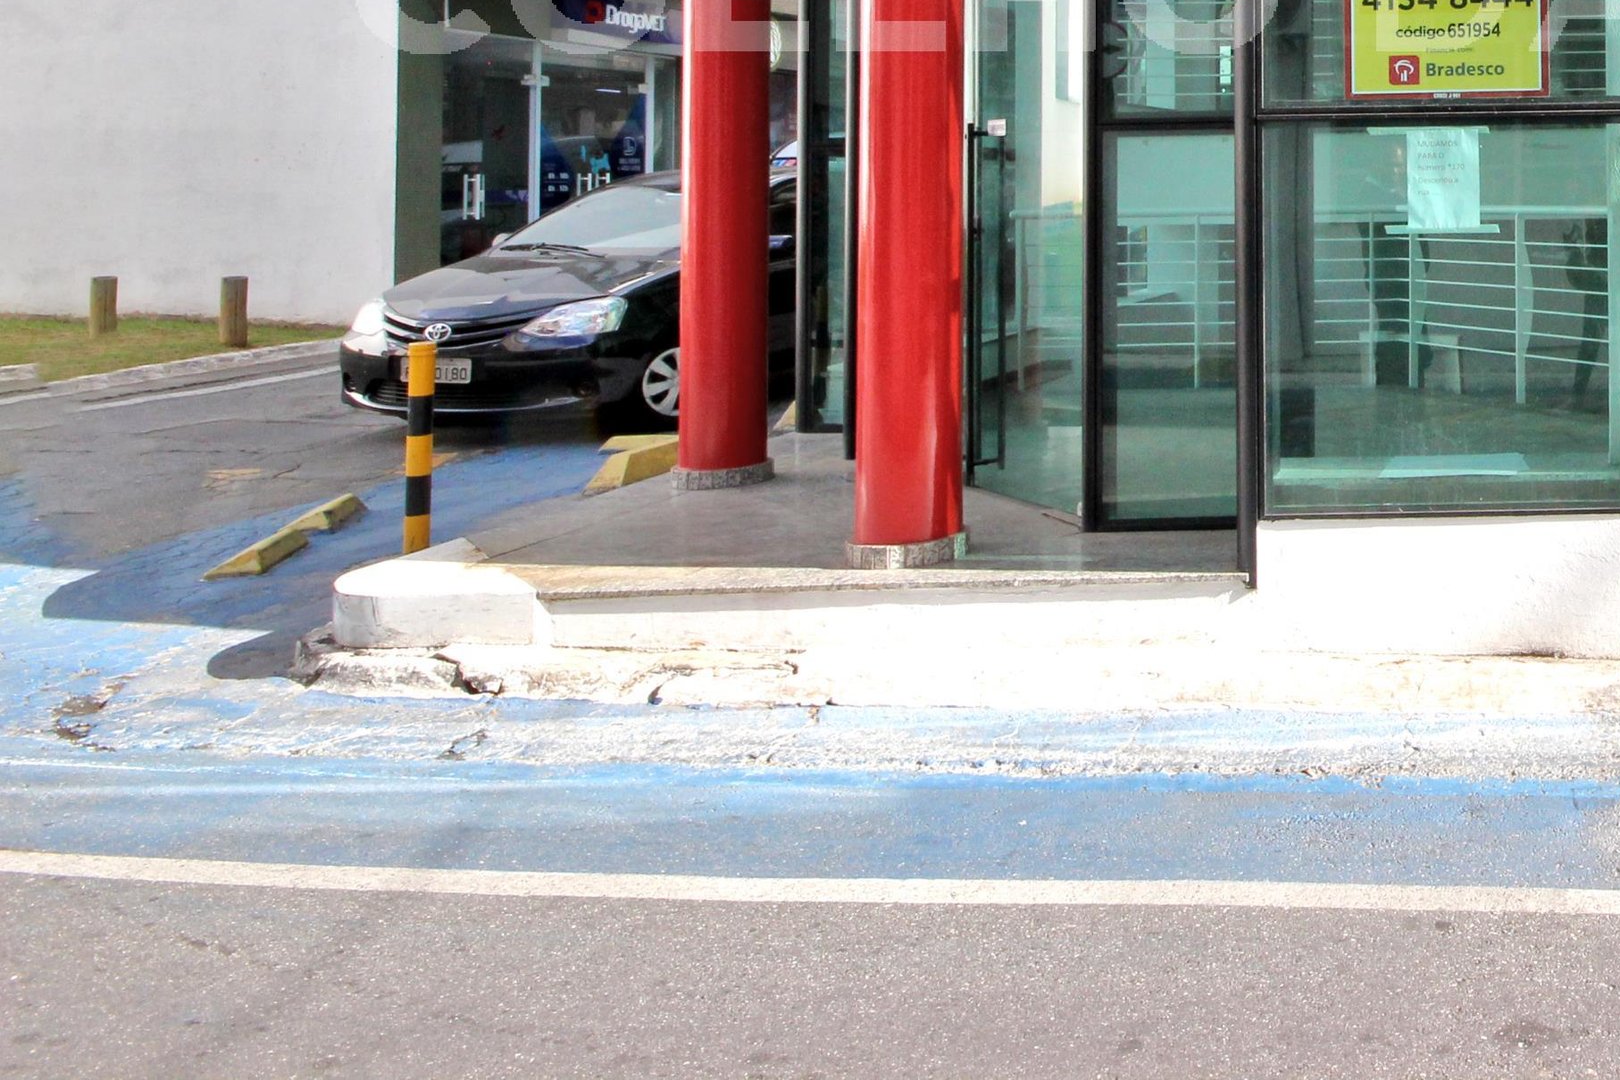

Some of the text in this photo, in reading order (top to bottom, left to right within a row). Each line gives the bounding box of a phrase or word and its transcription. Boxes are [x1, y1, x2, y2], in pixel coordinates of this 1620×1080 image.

[1396, 22, 1501, 39] código 651954
[1426, 62, 1505, 77] Bradesco
